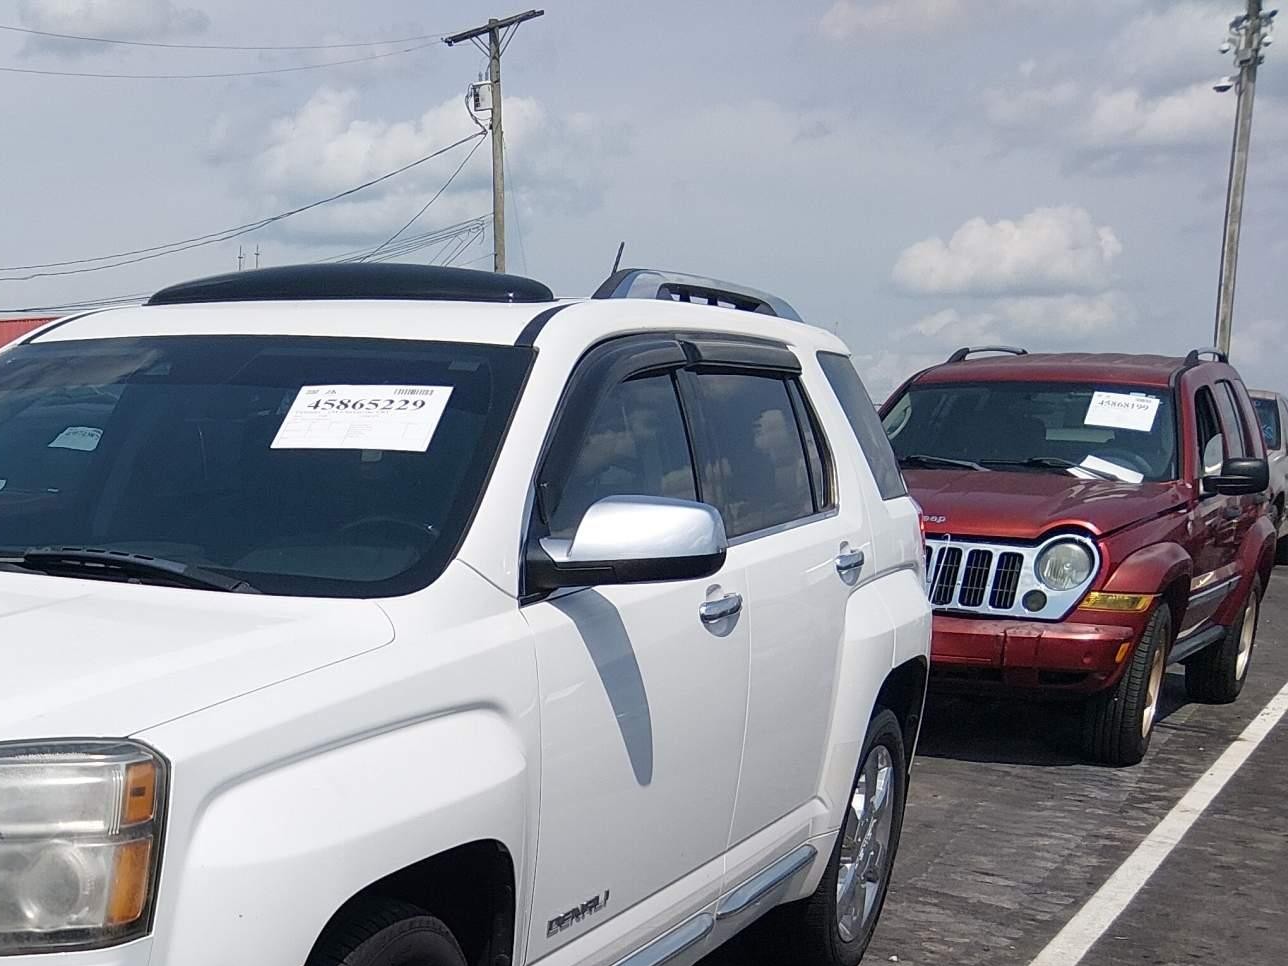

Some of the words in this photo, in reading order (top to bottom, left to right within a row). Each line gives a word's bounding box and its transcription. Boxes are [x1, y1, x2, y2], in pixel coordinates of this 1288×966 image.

[306, 398, 426, 411] 45865229
[923, 515, 946, 524] eep
[546, 888, 610, 938] DENALI
